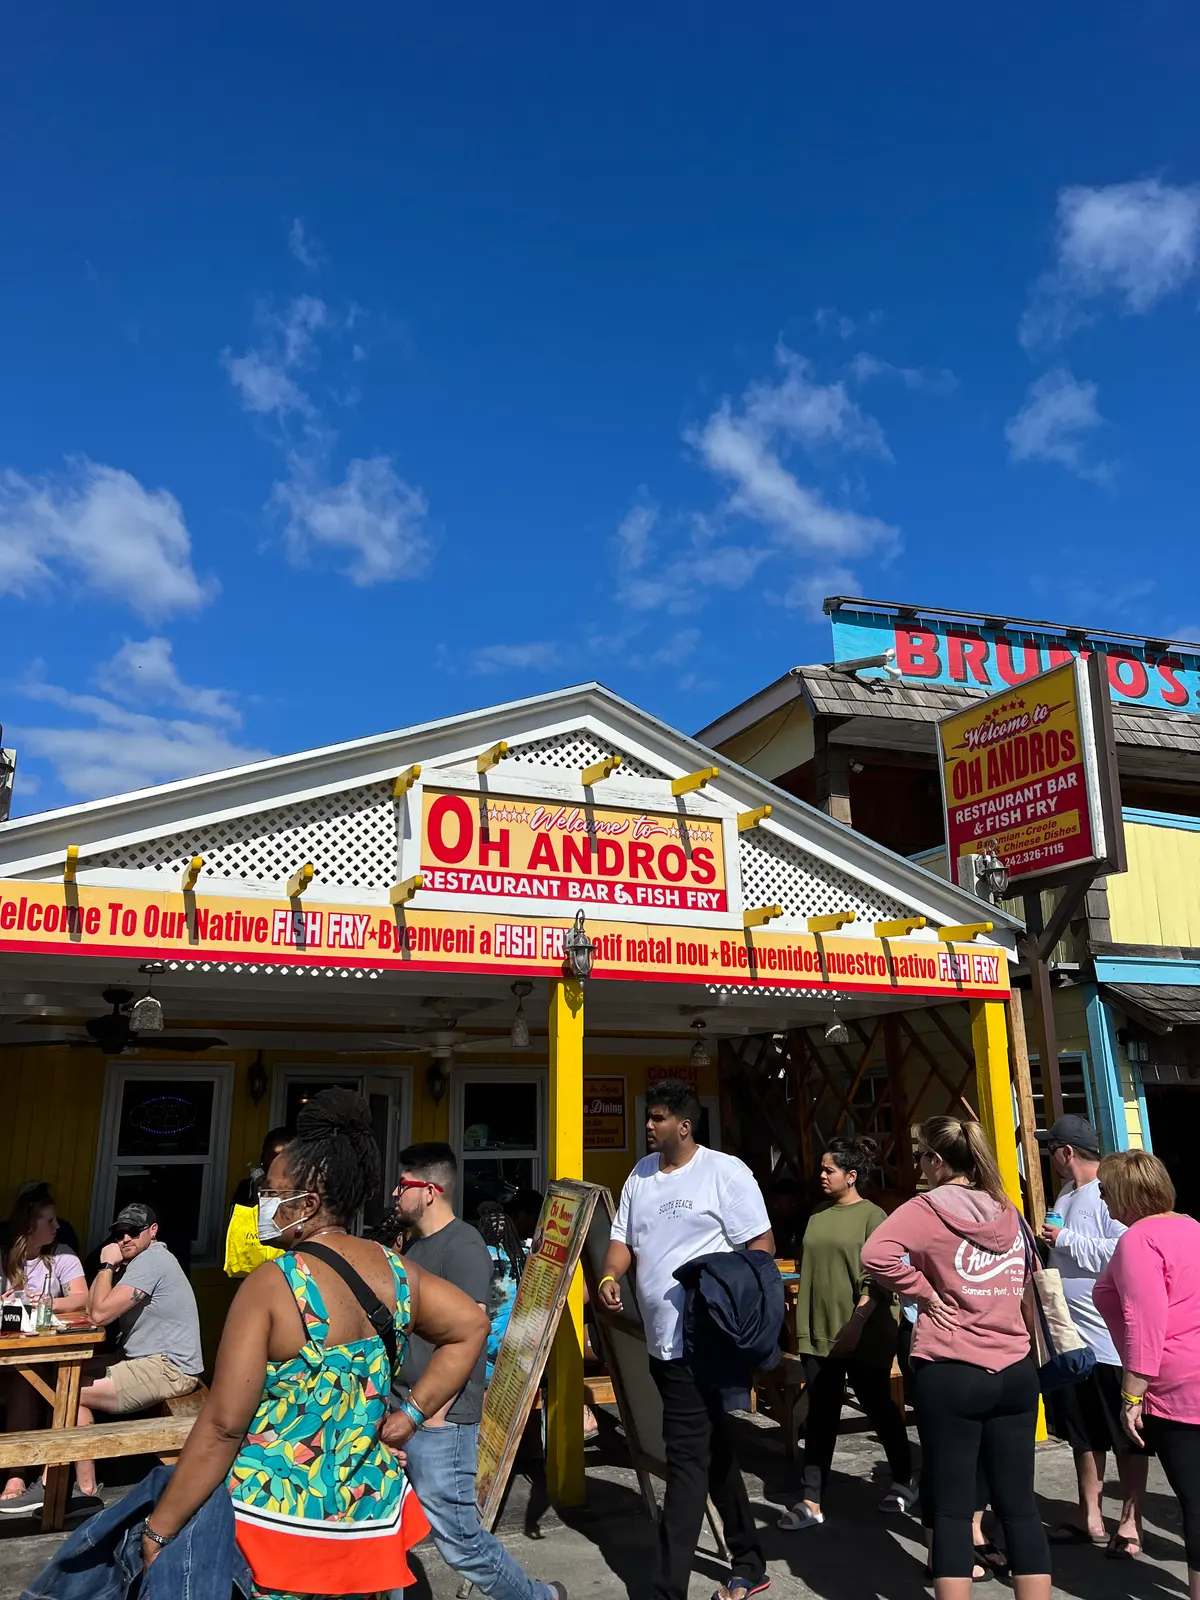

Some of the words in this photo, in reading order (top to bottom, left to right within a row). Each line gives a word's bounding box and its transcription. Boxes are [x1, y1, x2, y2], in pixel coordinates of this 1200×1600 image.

[964, 712, 1030, 751] Welcome
[1032, 703, 1050, 724] to
[952, 756, 983, 800] OH
[988, 729, 1076, 790] ANDROS
[955, 783, 1043, 824] RESTAURANT
[1047, 772, 1078, 795] BAR
[529, 806, 630, 836] Welcome
[973, 821, 985, 836] &
[986, 807, 1021, 832] FISH
[1026, 796, 1059, 819] FRY
[1026, 819, 1058, 836] Creole
[427, 795, 510, 867] OH
[527, 832, 717, 885] ANDROS
[1003, 836, 1041, 852] Chinese
[1044, 824, 1078, 841] Dishes
[1004, 842, 1065, 868] 242.326-7115
[421, 870, 561, 899] RESTAURANT
[568, 881, 609, 901] BAR
[613, 883, 634, 905] &
[637, 887, 679, 906] FISH
[687, 891, 721, 909] FRY
[0, 896, 101, 935] elcome
[108, 902, 138, 937] To
[143, 904, 188, 939] Our
[193, 908, 269, 943] Native
[272, 908, 324, 947] FISH
[327, 911, 372, 949] FRY
[378, 919, 475, 954] Byenveni
[479, 930, 492, 955] a
[494, 922, 537, 959] FISH
[541, 925, 570, 961] FR
[586, 933, 622, 961] atif
[626, 936, 672, 965] natal
[676, 941, 709, 967] nou
[825, 950, 886, 977] nuestro
[889, 953, 937, 980] nativo
[938, 952, 972, 983] FISH
[972, 953, 999, 984] FRY
[647, 1066, 698, 1080] CONCH
[589, 1099, 623, 1114] Dining
[675, 1199, 693, 1210] BEACH
[961, 1285, 992, 1296] Somers
